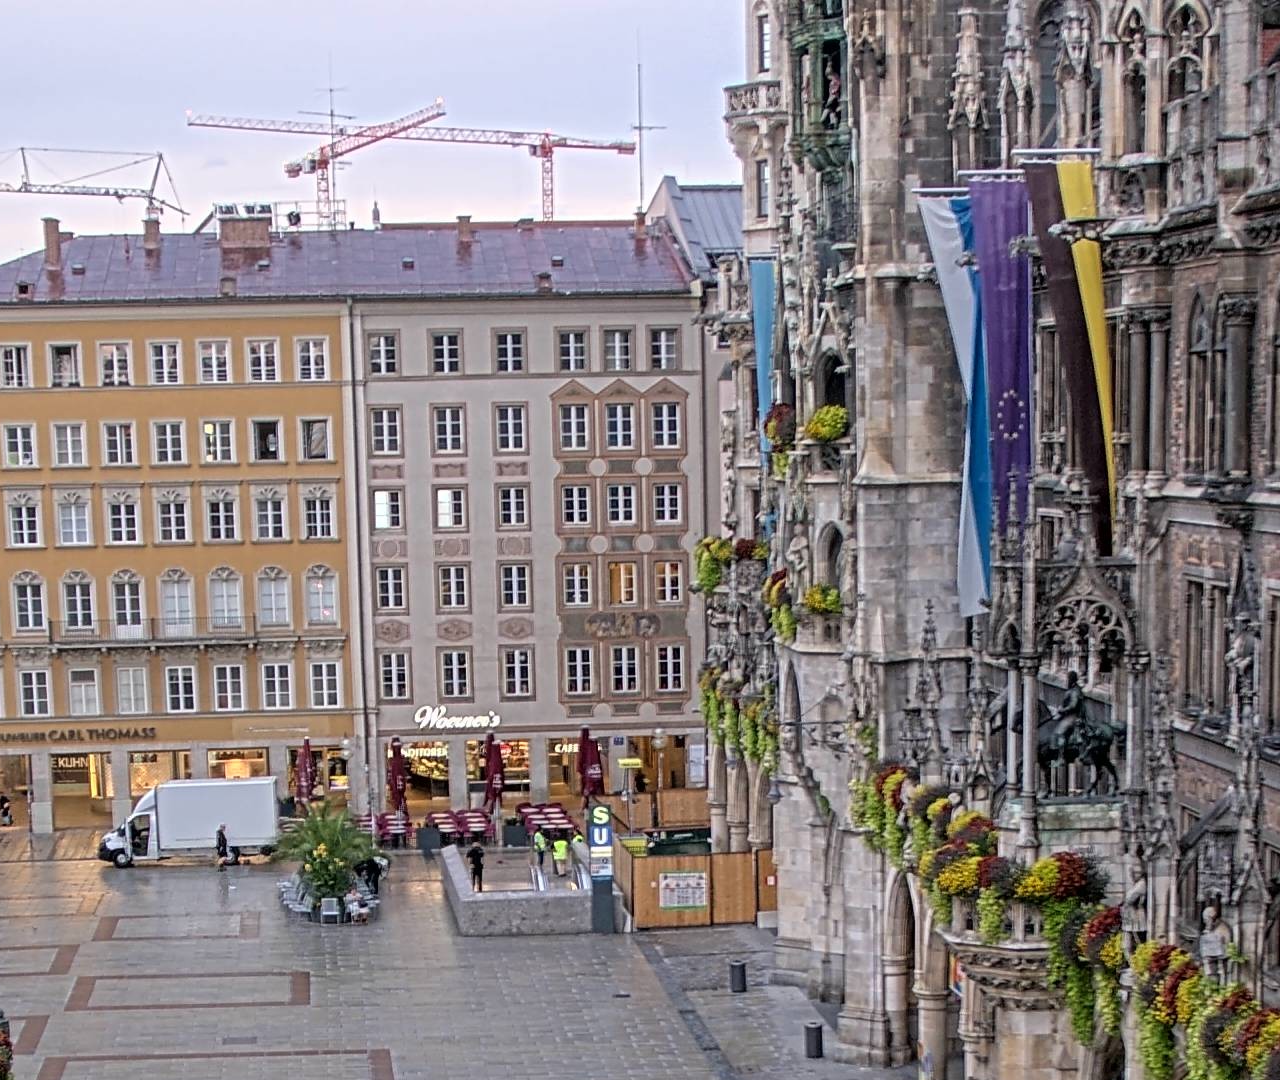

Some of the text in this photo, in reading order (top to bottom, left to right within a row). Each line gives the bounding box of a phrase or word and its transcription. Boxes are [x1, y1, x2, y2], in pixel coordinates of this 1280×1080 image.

[48, 730, 84, 742] CARL
[86, 727, 157, 741] THOMASS
[592, 806, 609, 825] S
[593, 828, 609, 845] U
